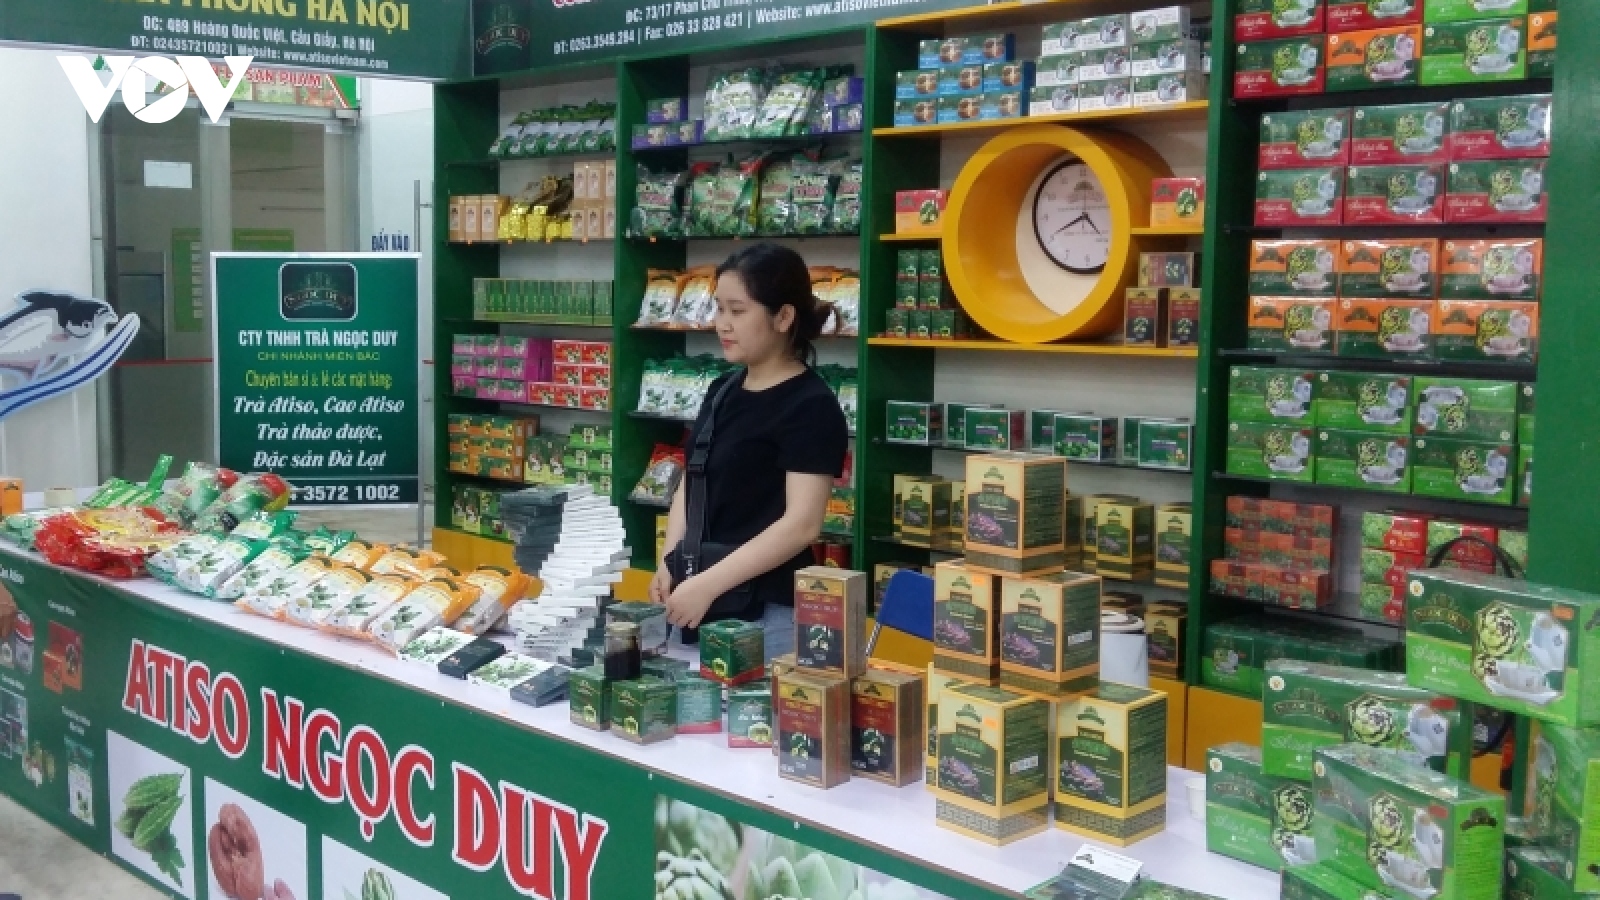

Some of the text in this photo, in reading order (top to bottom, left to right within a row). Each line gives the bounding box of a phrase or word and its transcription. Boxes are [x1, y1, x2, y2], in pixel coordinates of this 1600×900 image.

[755, 6, 803, 24] Website:
[238, 327, 399, 350] CTY TNHH TRÀ NGỌC DUY
[233, 394, 266, 414] Trà
[323, 395, 357, 414] Cao
[359, 396, 405, 414] Atiso
[257, 422, 288, 441] Trà
[303, 485, 349, 501] 3572
[355, 485, 400, 501] 1002
[121, 637, 609, 900] ATISO NGỌC DUY
